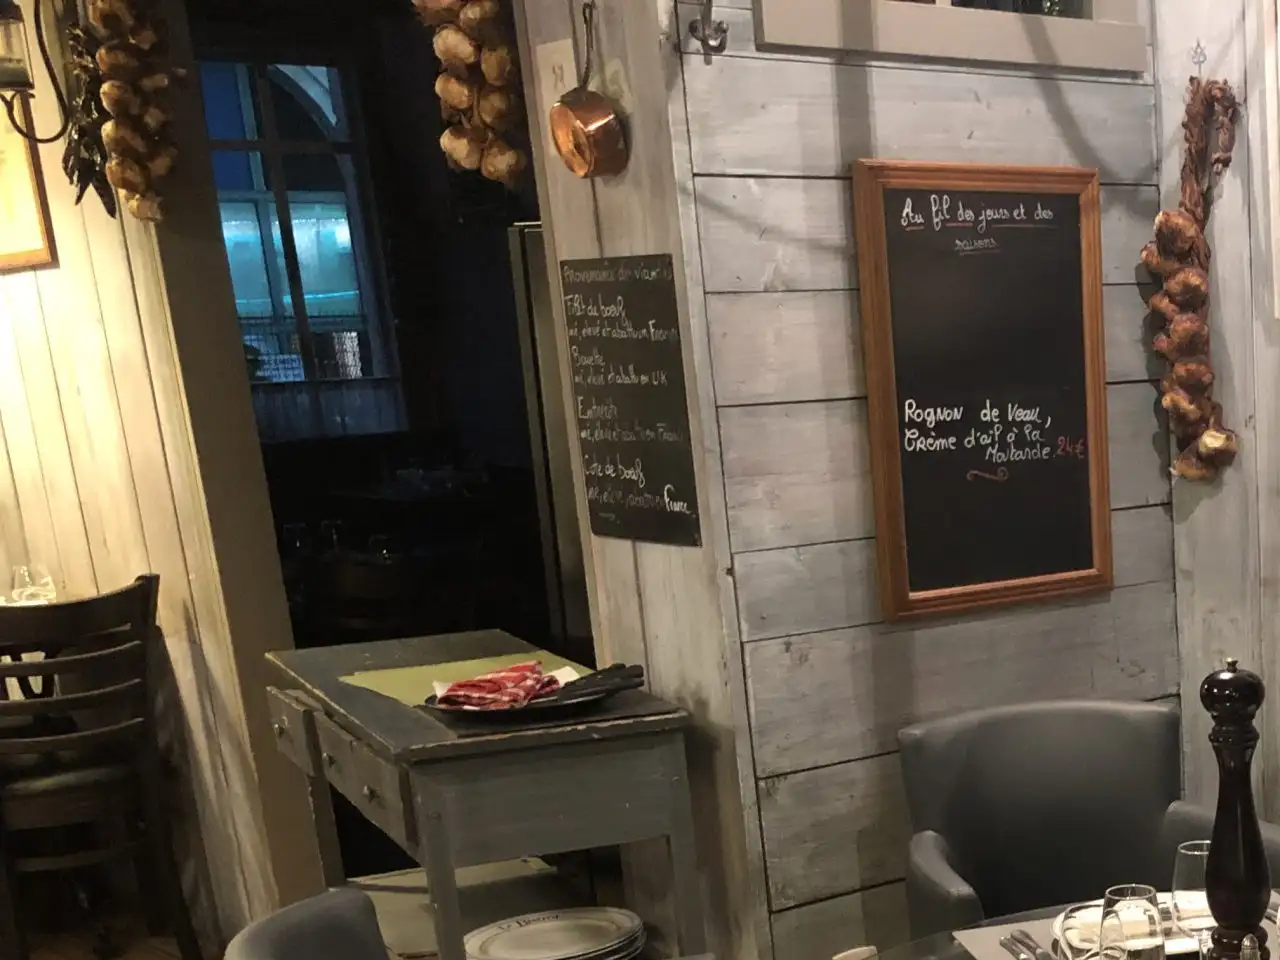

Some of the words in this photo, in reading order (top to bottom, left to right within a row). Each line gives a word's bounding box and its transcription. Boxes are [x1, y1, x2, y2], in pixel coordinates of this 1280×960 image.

[901, 197, 925, 227] Au
[930, 194, 951, 231] fil
[957, 201, 975, 221] des
[978, 203, 1010, 233] jours
[1013, 203, 1027, 220] et
[1034, 202, 1053, 220] des
[980, 399, 1000, 423] de
[1023, 424, 1046, 442] la
